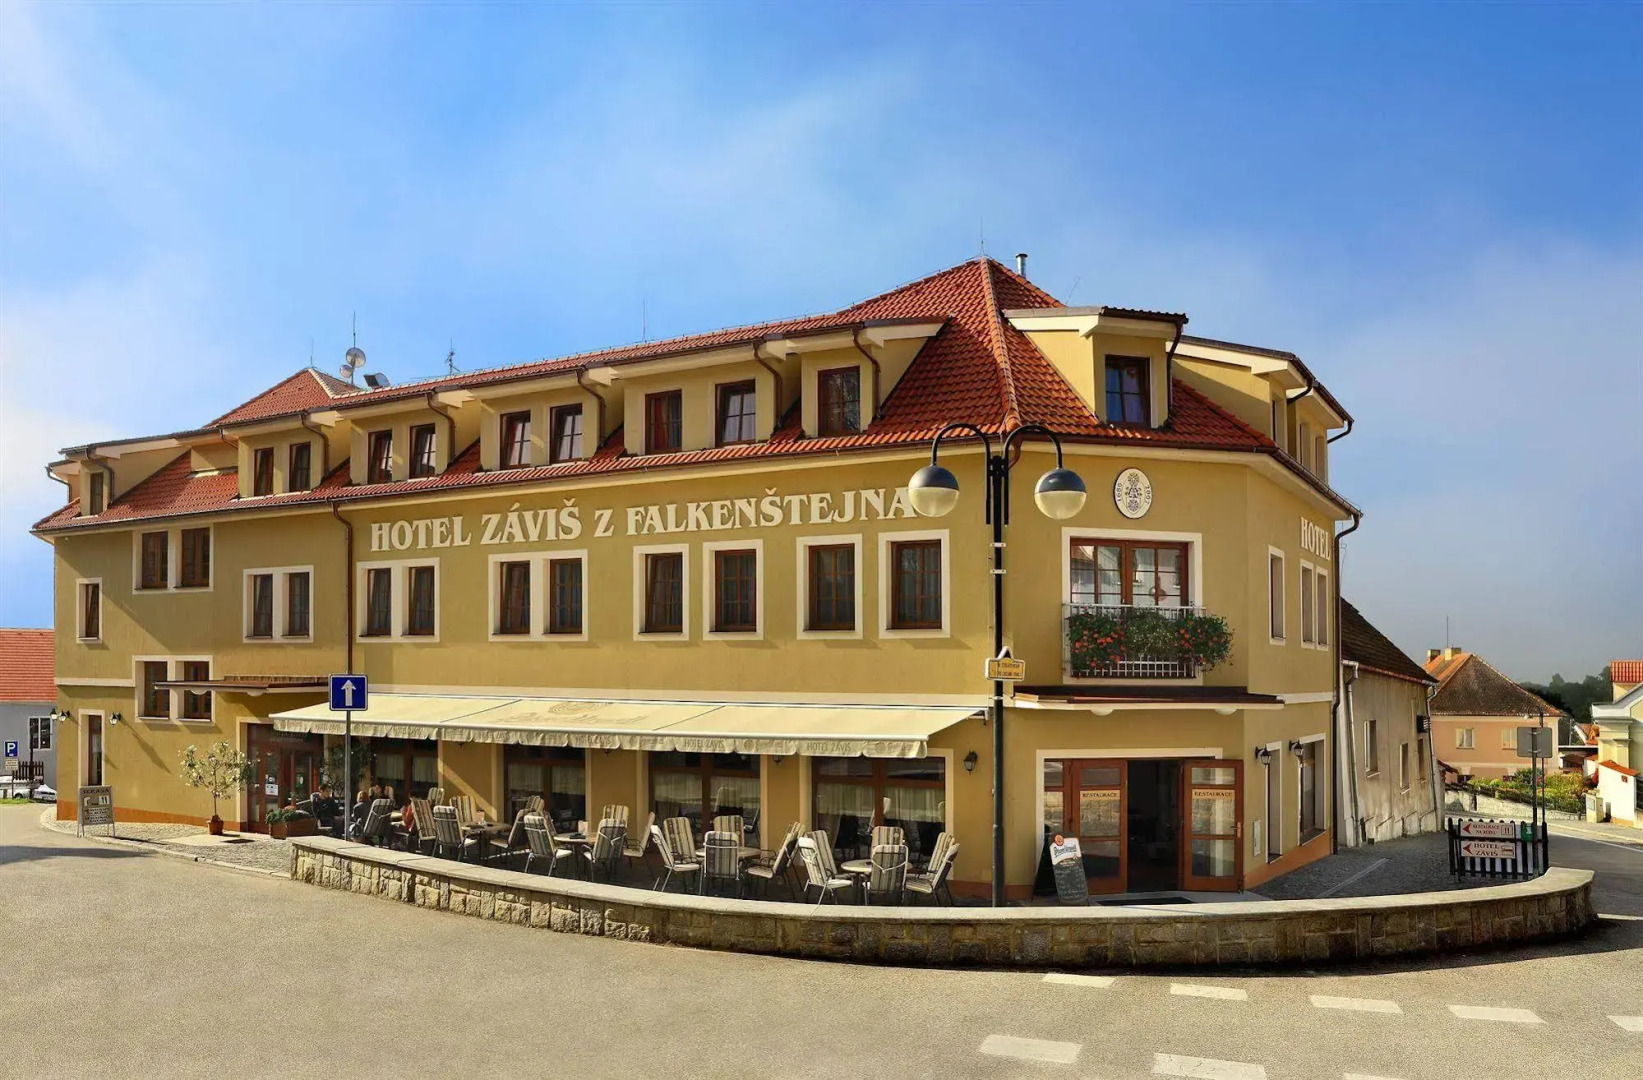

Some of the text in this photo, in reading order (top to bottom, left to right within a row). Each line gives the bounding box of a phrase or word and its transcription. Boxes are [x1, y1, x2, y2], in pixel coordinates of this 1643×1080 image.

[371, 487, 918, 551] HOTEL ZÁVIŠ Z FALKENŠTEJNA
[1300, 516, 1330, 561] HOTEL
[7, 743, 16, 753] P
